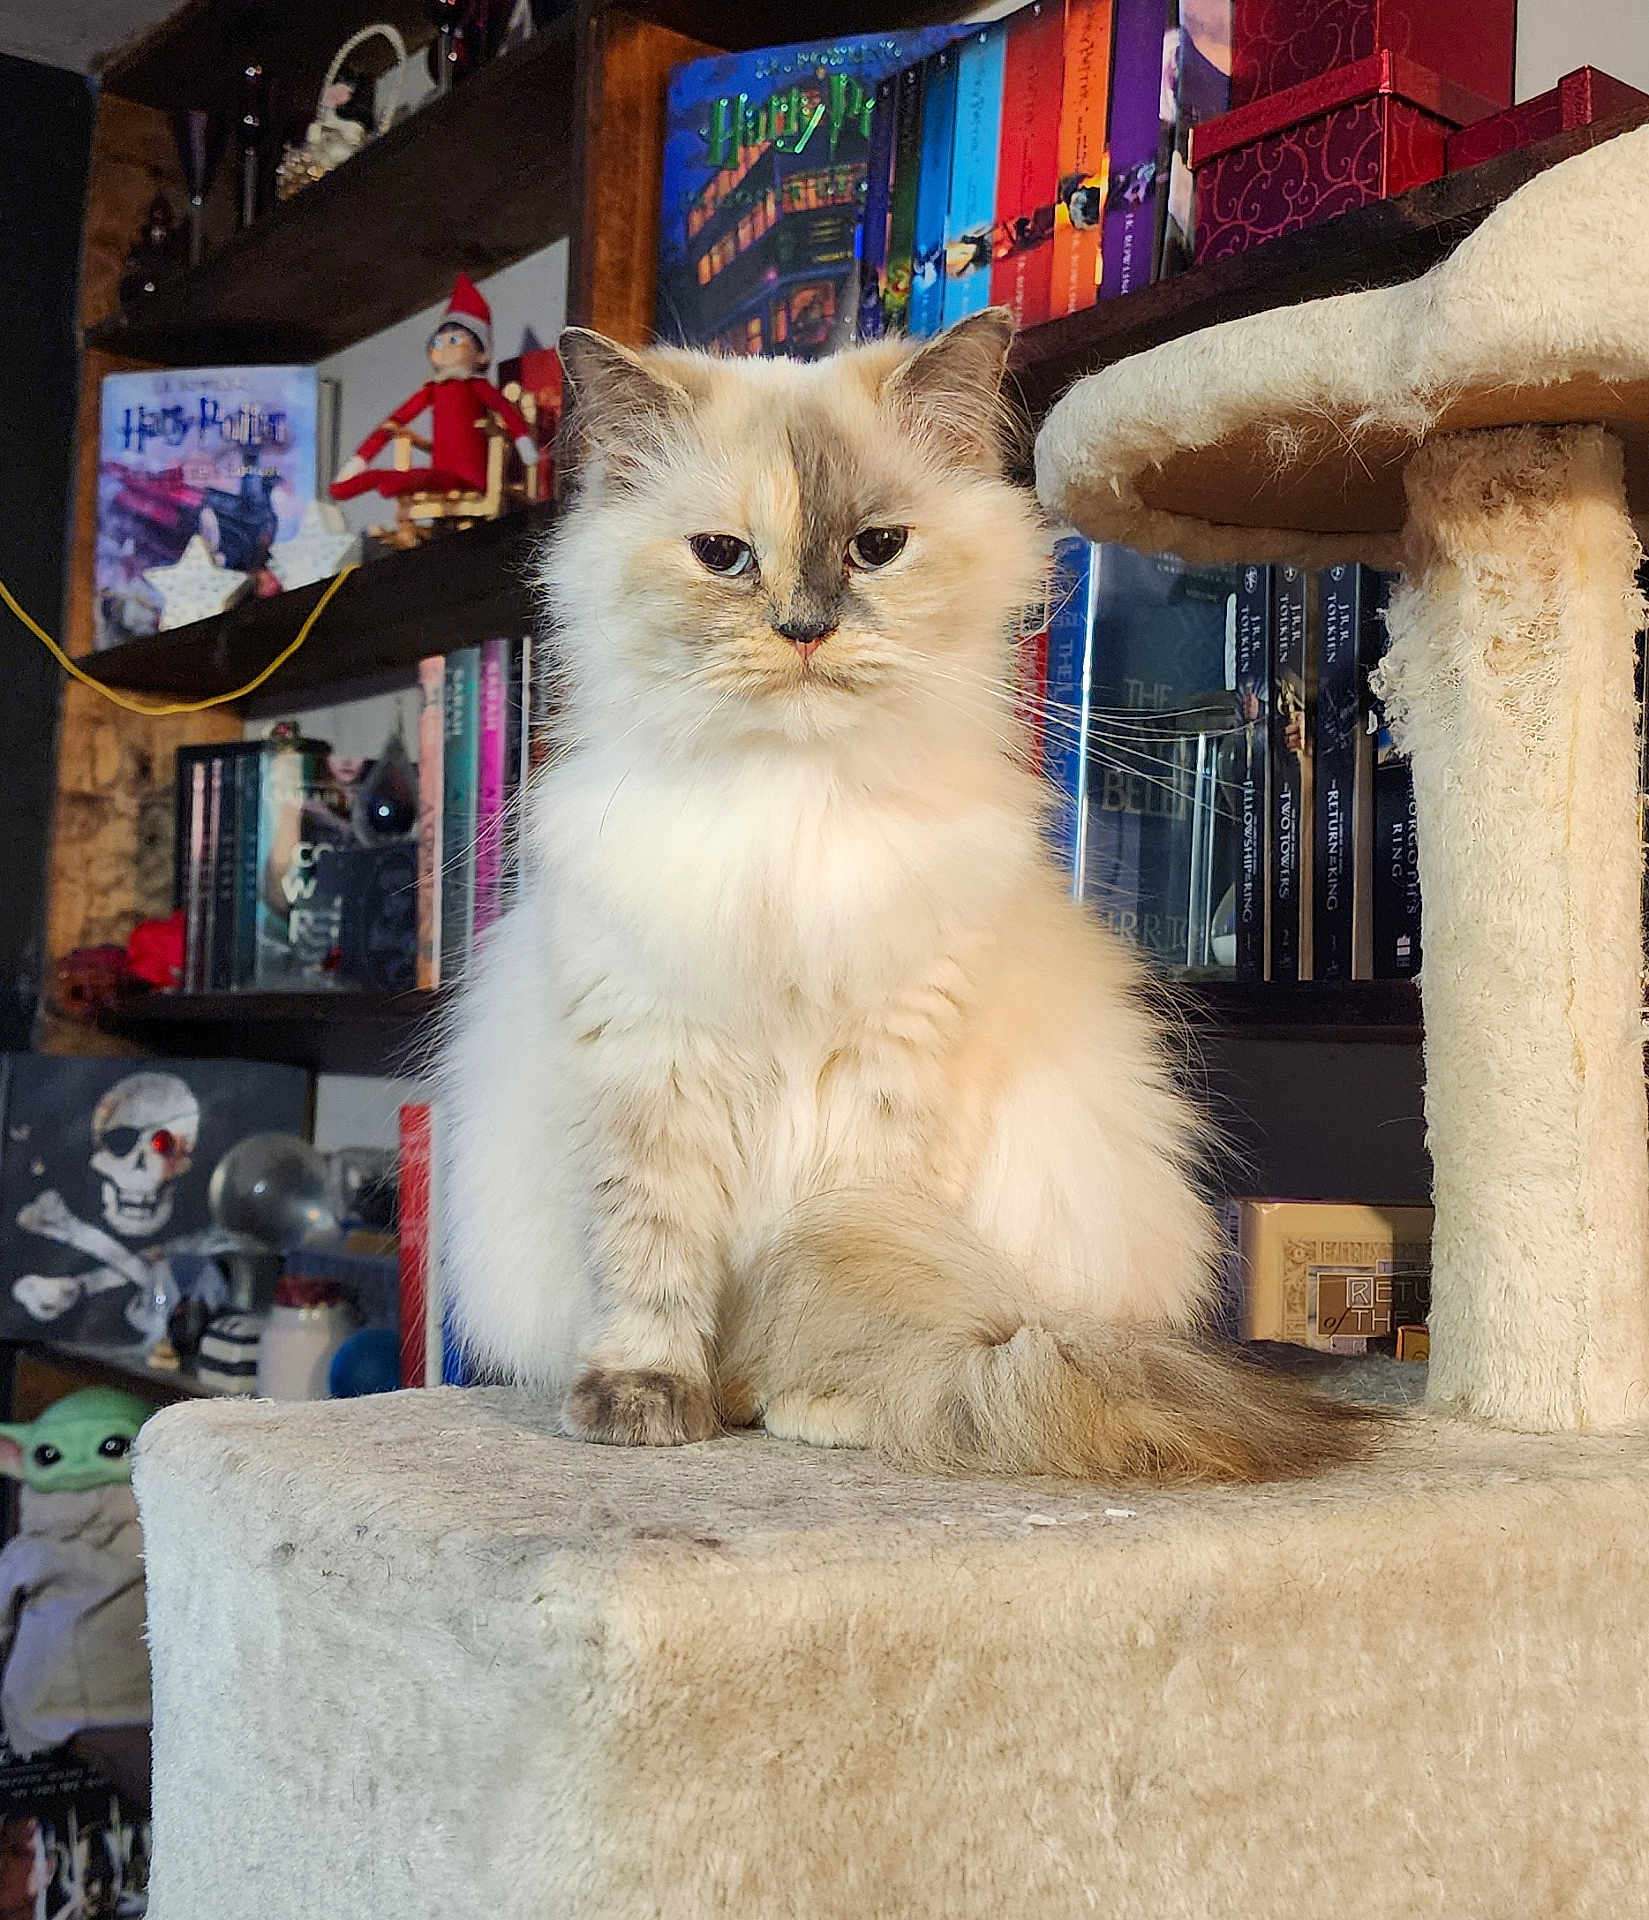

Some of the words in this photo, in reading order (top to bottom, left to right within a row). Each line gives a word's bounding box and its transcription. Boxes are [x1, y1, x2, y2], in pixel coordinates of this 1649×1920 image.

[1240, 605, 1250, 674] TOLKIEN
[1279, 592, 1290, 663] TOLKIEN
[1327, 592, 1338, 663] TOLKIEN
[1279, 788, 1292, 830] TWO
[1326, 789, 1339, 854] RETURN
[1279, 831, 1291, 899] TOWERS
[1391, 823, 1405, 878] RING
[1242, 881, 1254, 922] RING
[1326, 866, 1339, 911] KING
